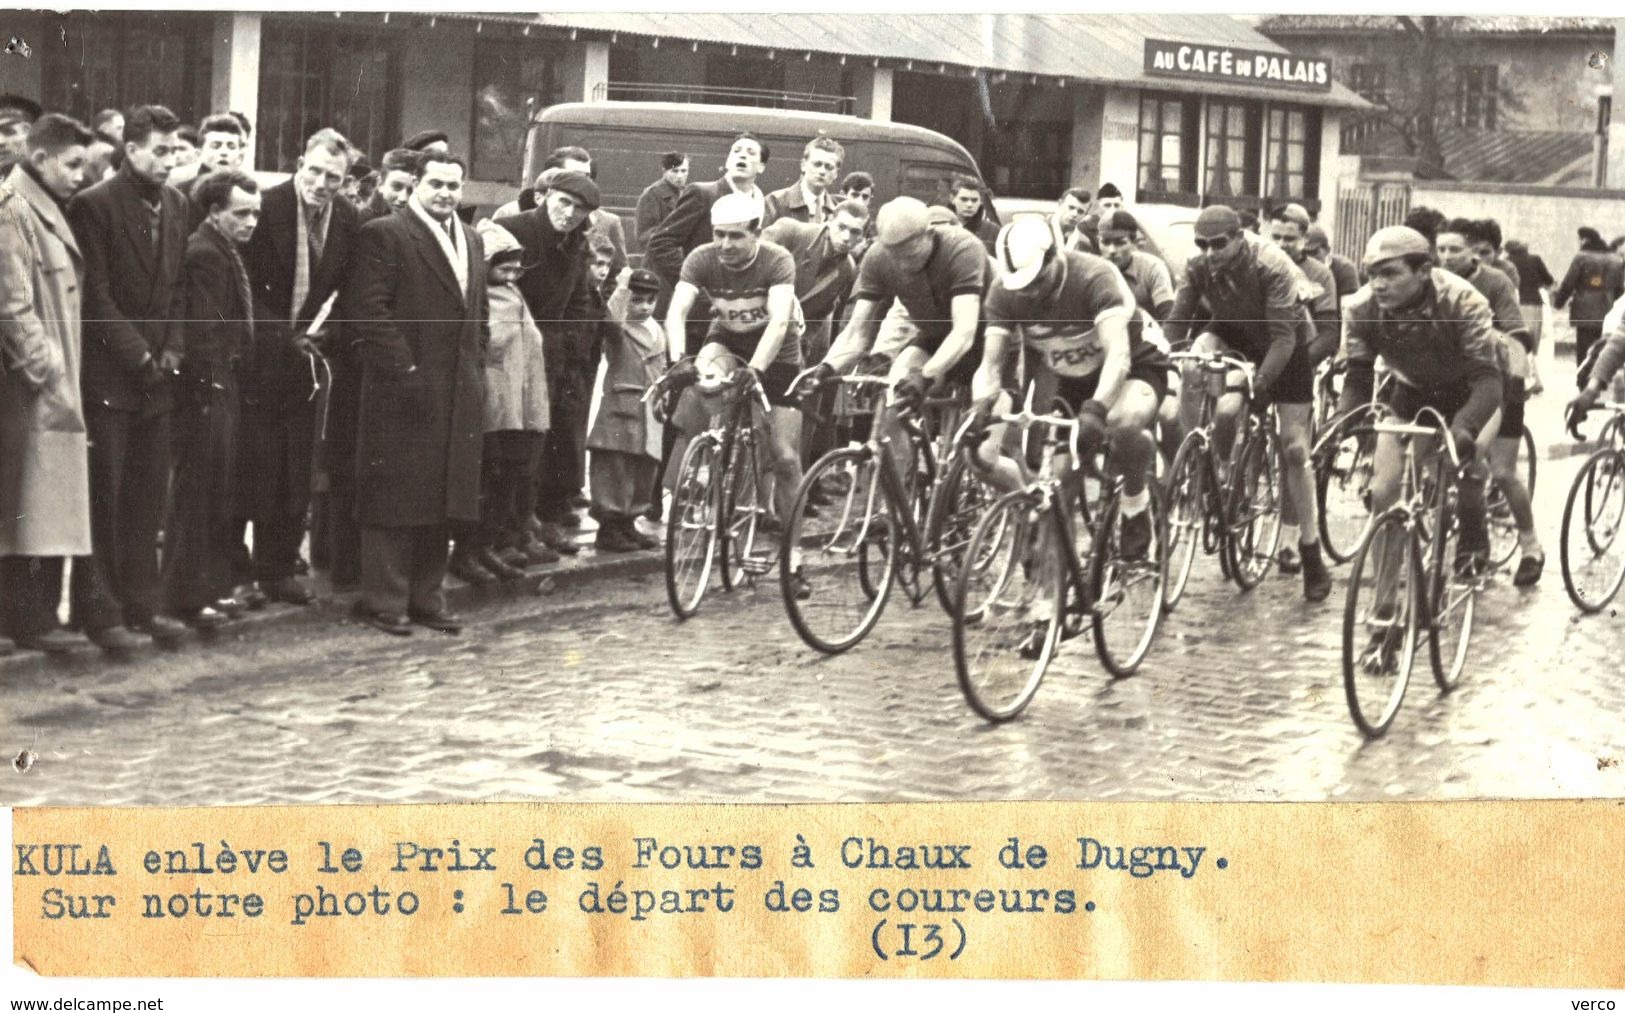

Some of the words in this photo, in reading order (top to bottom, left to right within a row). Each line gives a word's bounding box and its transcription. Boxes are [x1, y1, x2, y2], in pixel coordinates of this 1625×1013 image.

[1154, 51, 1174, 70] AU
[1177, 46, 1232, 75] CAFÉ
[1236, 59, 1251, 77] DU
[1255, 55, 1327, 84] PALAIS
[14, 843, 118, 876] KULA
[143, 839, 289, 875] enlève
[317, 841, 363, 874] le
[391, 842, 497, 873] Prix
[524, 839, 605, 872] des
[632, 837, 763, 870] Fours
[791, 834, 815, 869] à
[841, 837, 972, 870] Chaux
[998, 838, 1049, 869] de
[1076, 837, 1230, 878] Dugny.
[41, 888, 117, 919] Sur
[141, 886, 265, 918] notre
[290, 884, 420, 925] photo
[453, 890, 465, 913] :
[501, 882, 549, 915] le
[578, 880, 735, 922] départ
[764, 880, 842, 914] des
[868, 887, 1097, 914] coureurs.
